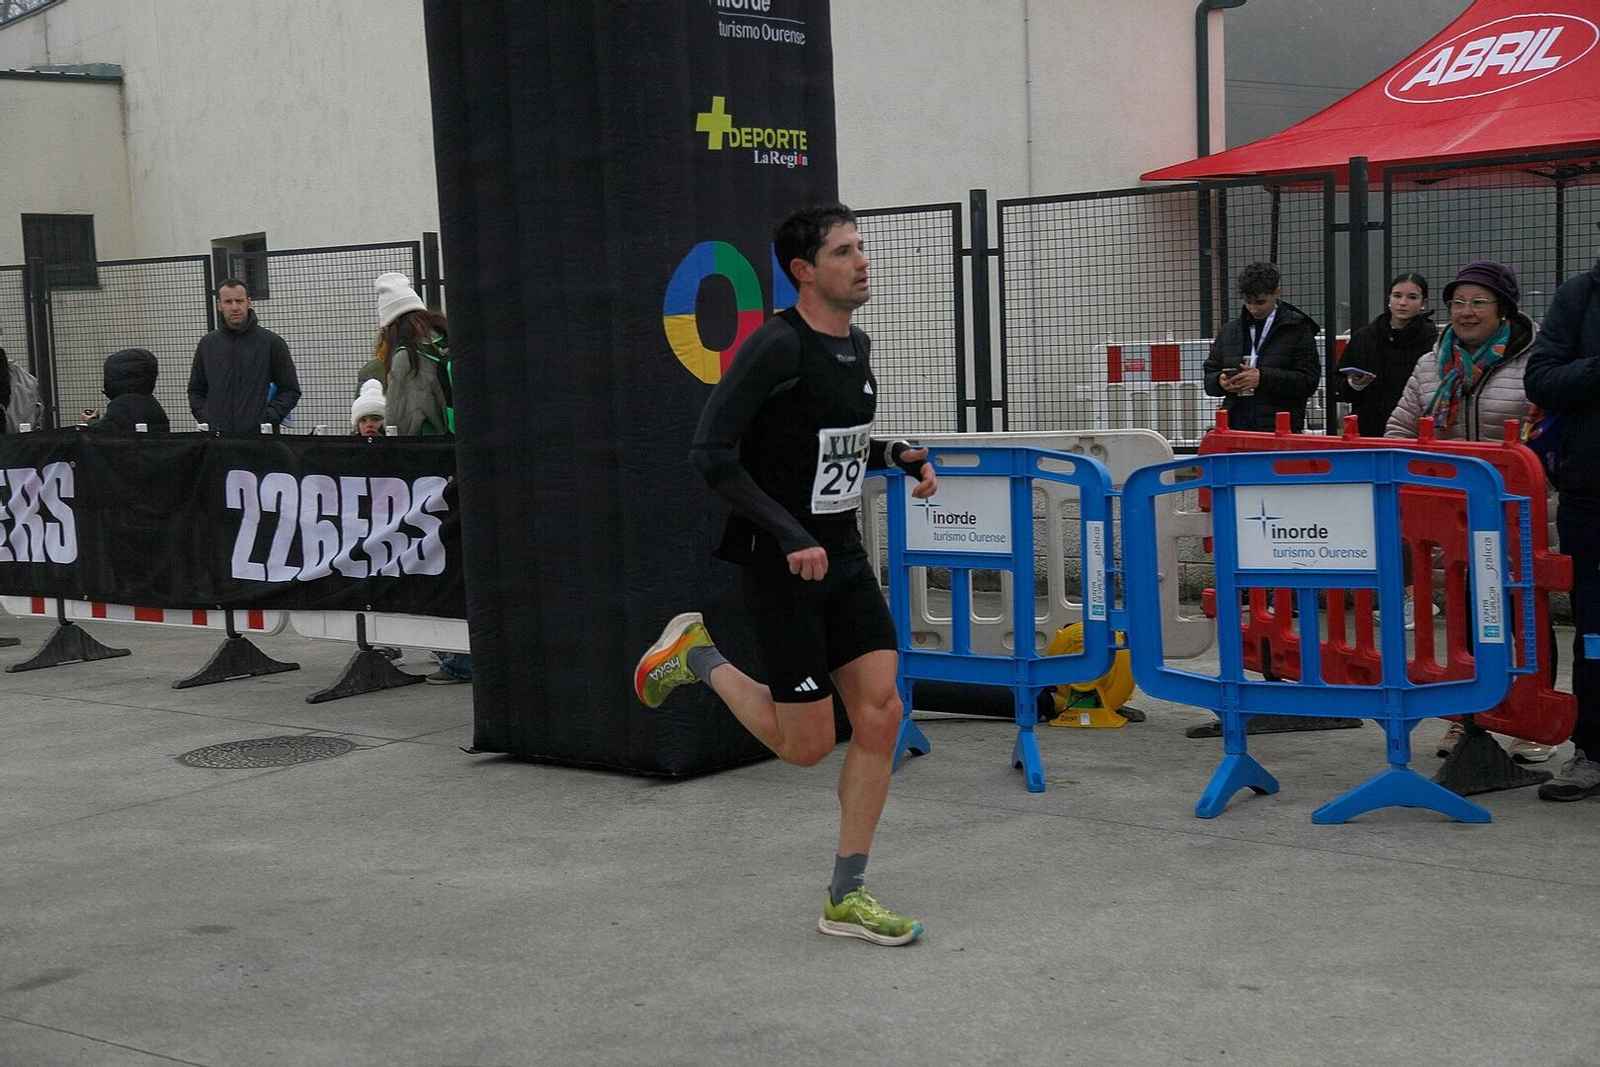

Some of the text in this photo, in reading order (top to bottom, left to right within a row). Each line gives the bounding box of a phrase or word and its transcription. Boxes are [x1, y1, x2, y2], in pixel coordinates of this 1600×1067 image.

[718, 21, 806, 45] turismo Ourense
[1398, 26, 1565, 92] ABRIL
[225, 469, 450, 583] 226ERS
[932, 511, 977, 525] inorde
[933, 531, 1006, 543] turismo Ourense
[1271, 524, 1329, 539] inorde
[1272, 546, 1368, 559] turismo Ourense
[649, 657, 680, 681] HOKA
